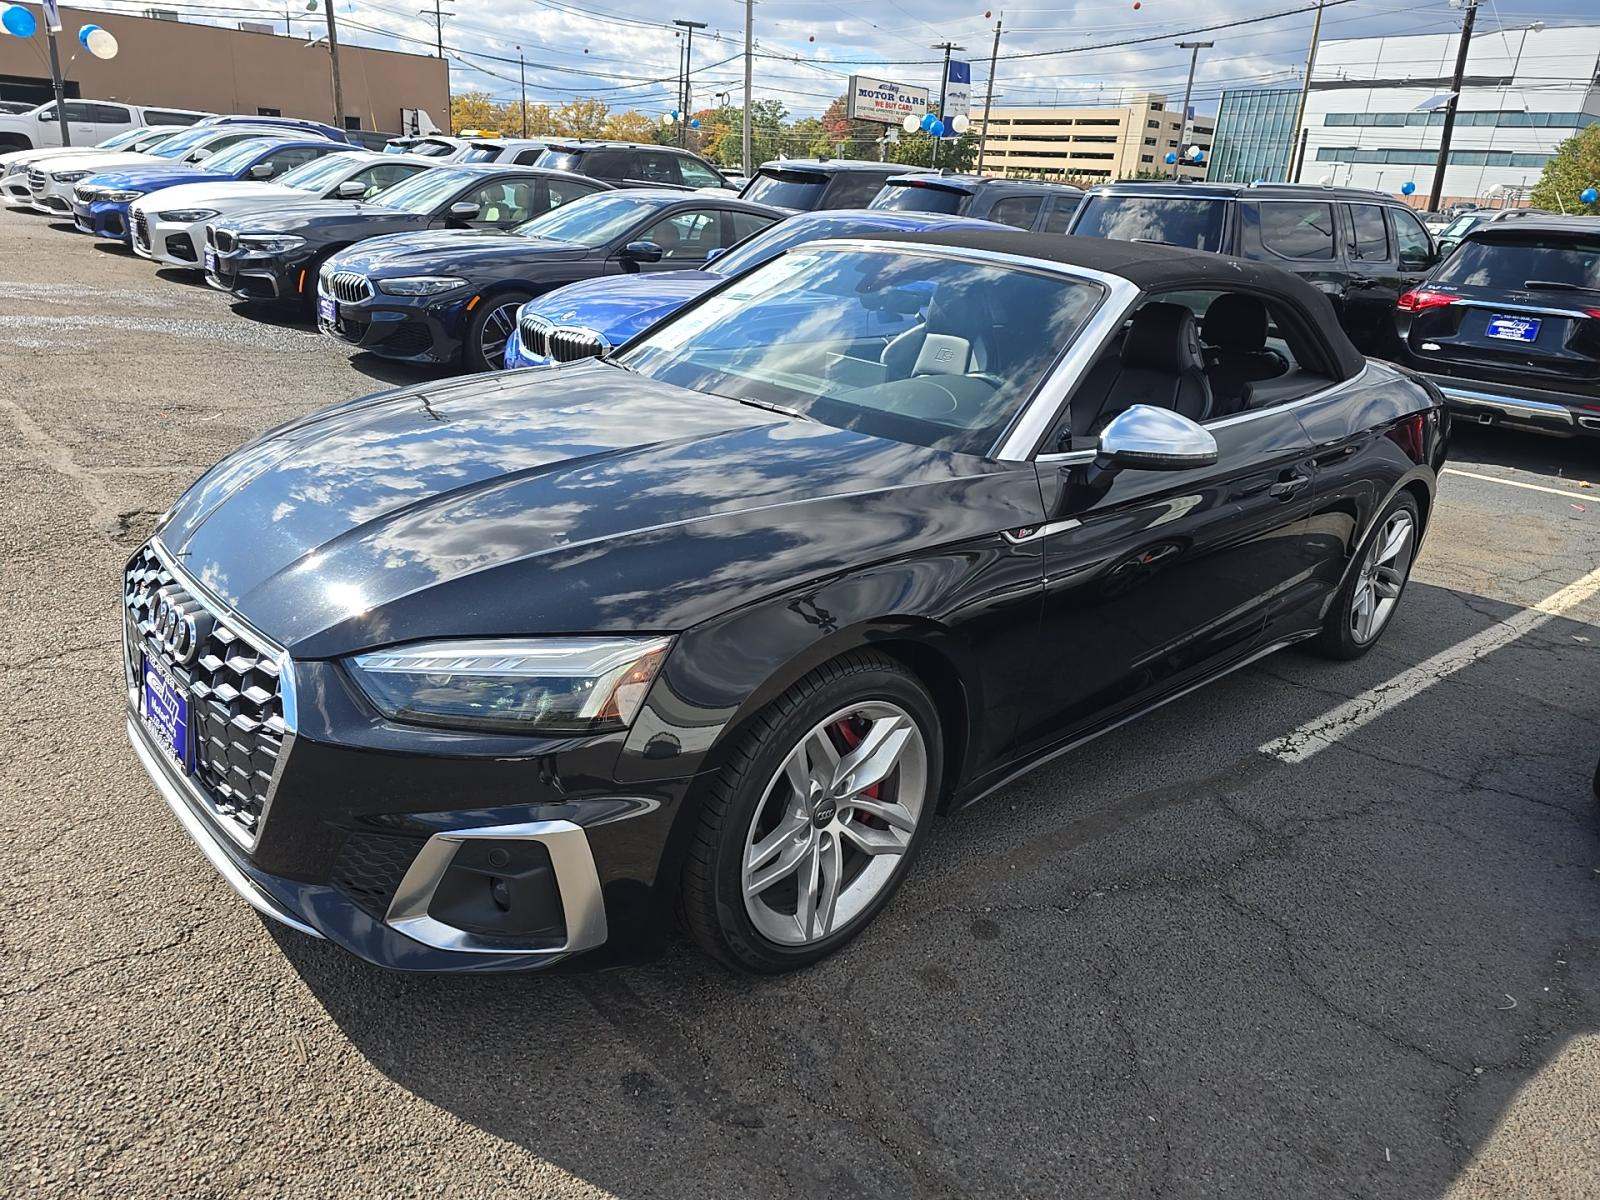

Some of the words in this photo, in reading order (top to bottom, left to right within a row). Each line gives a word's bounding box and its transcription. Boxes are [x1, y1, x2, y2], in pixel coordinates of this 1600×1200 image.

[858, 88, 895, 102] MOTOR
[899, 94, 926, 106] CARS
[885, 101, 897, 110] BUY
[898, 103, 913, 111] CARS
